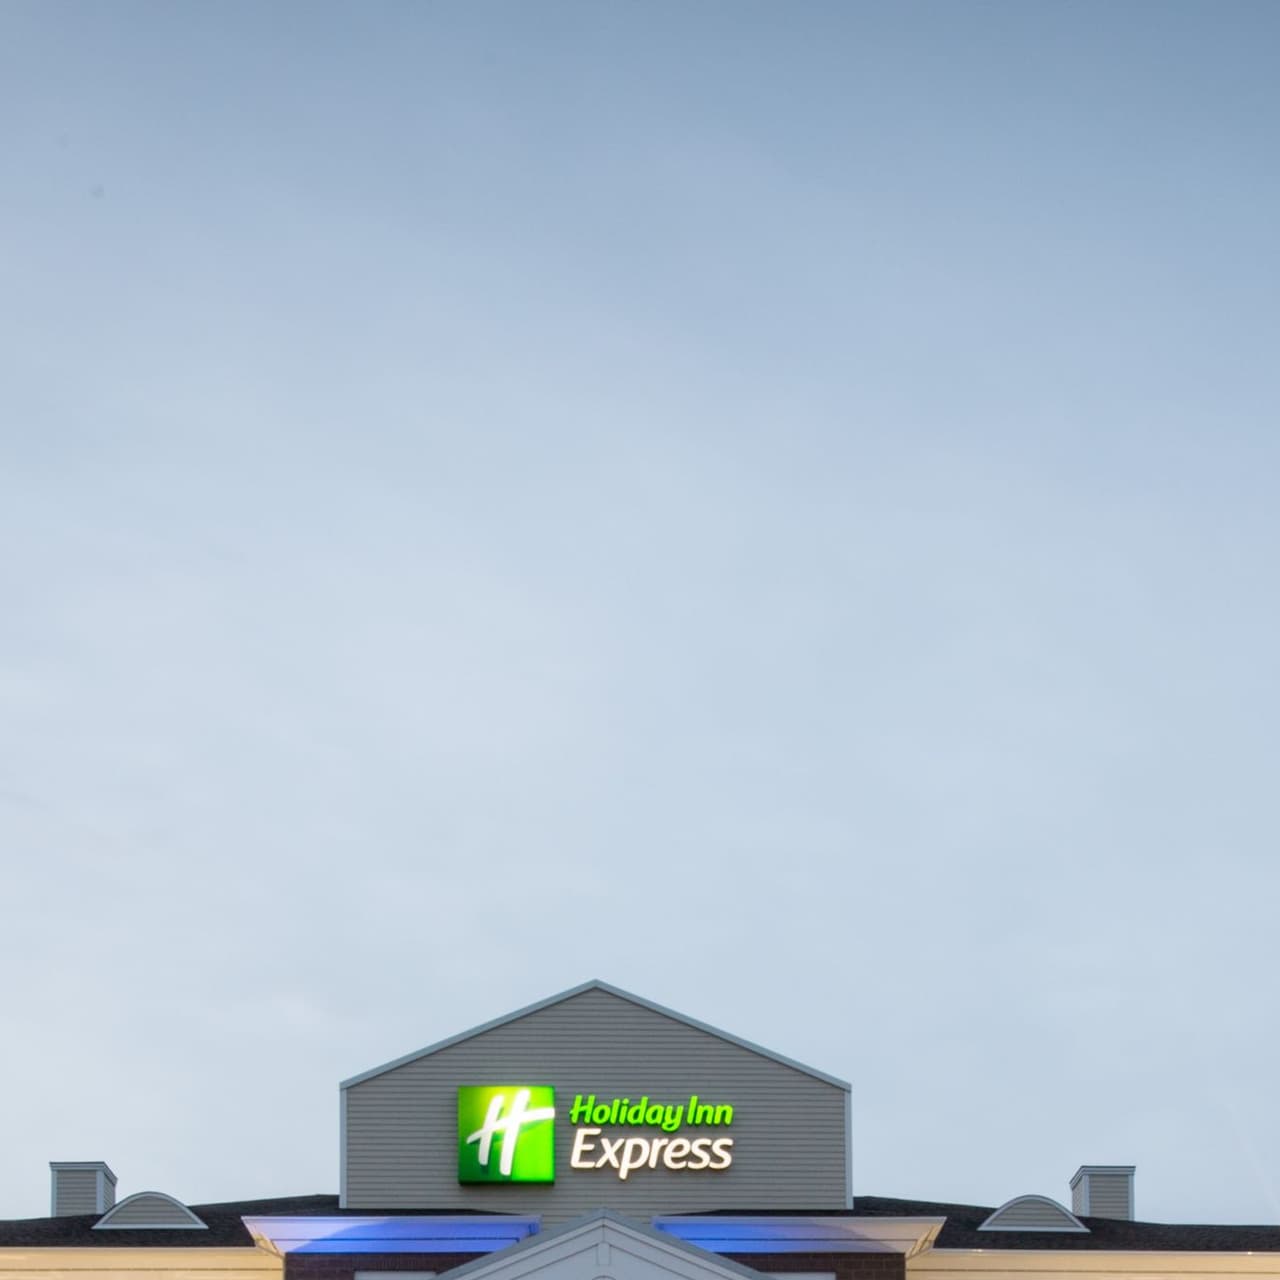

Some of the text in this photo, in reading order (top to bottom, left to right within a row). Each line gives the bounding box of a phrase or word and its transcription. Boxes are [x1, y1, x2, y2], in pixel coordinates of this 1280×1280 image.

[570, 1094, 734, 1132] Holiday Inn
[570, 1127, 734, 1180] Express
